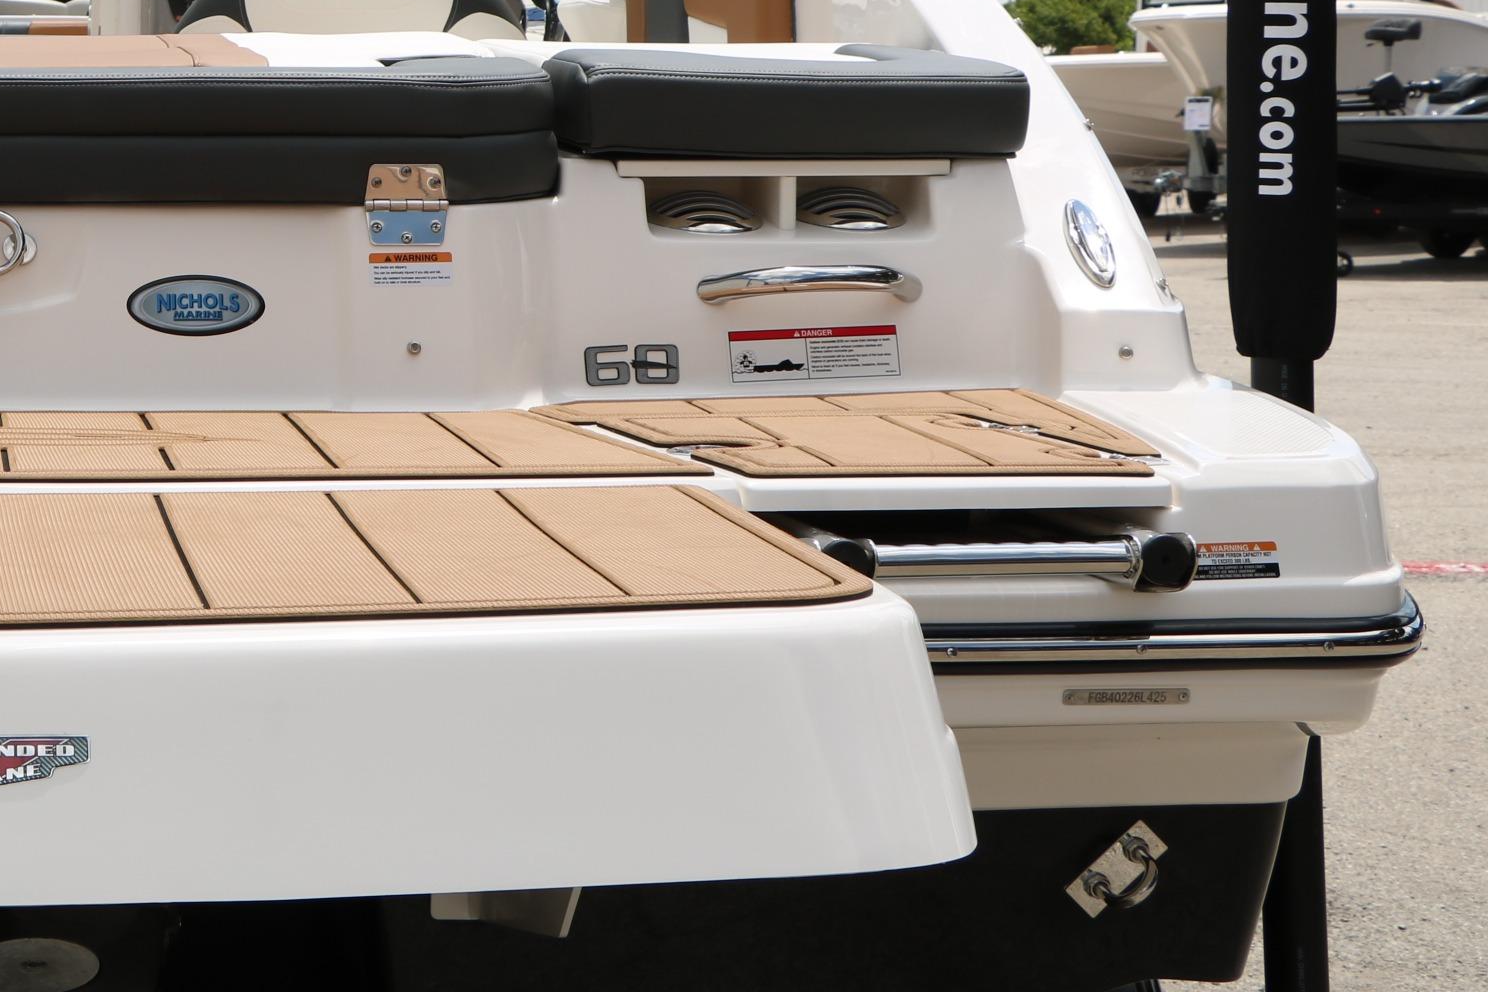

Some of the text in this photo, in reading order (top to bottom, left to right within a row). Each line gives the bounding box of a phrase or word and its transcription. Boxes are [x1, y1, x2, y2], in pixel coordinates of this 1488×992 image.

[393, 254, 438, 262] WARNING
[156, 292, 241, 313] NICHOLS
[173, 310, 224, 320] MARINE
[800, 329, 833, 337] DANGER
[1210, 543, 1249, 552] WARNING
